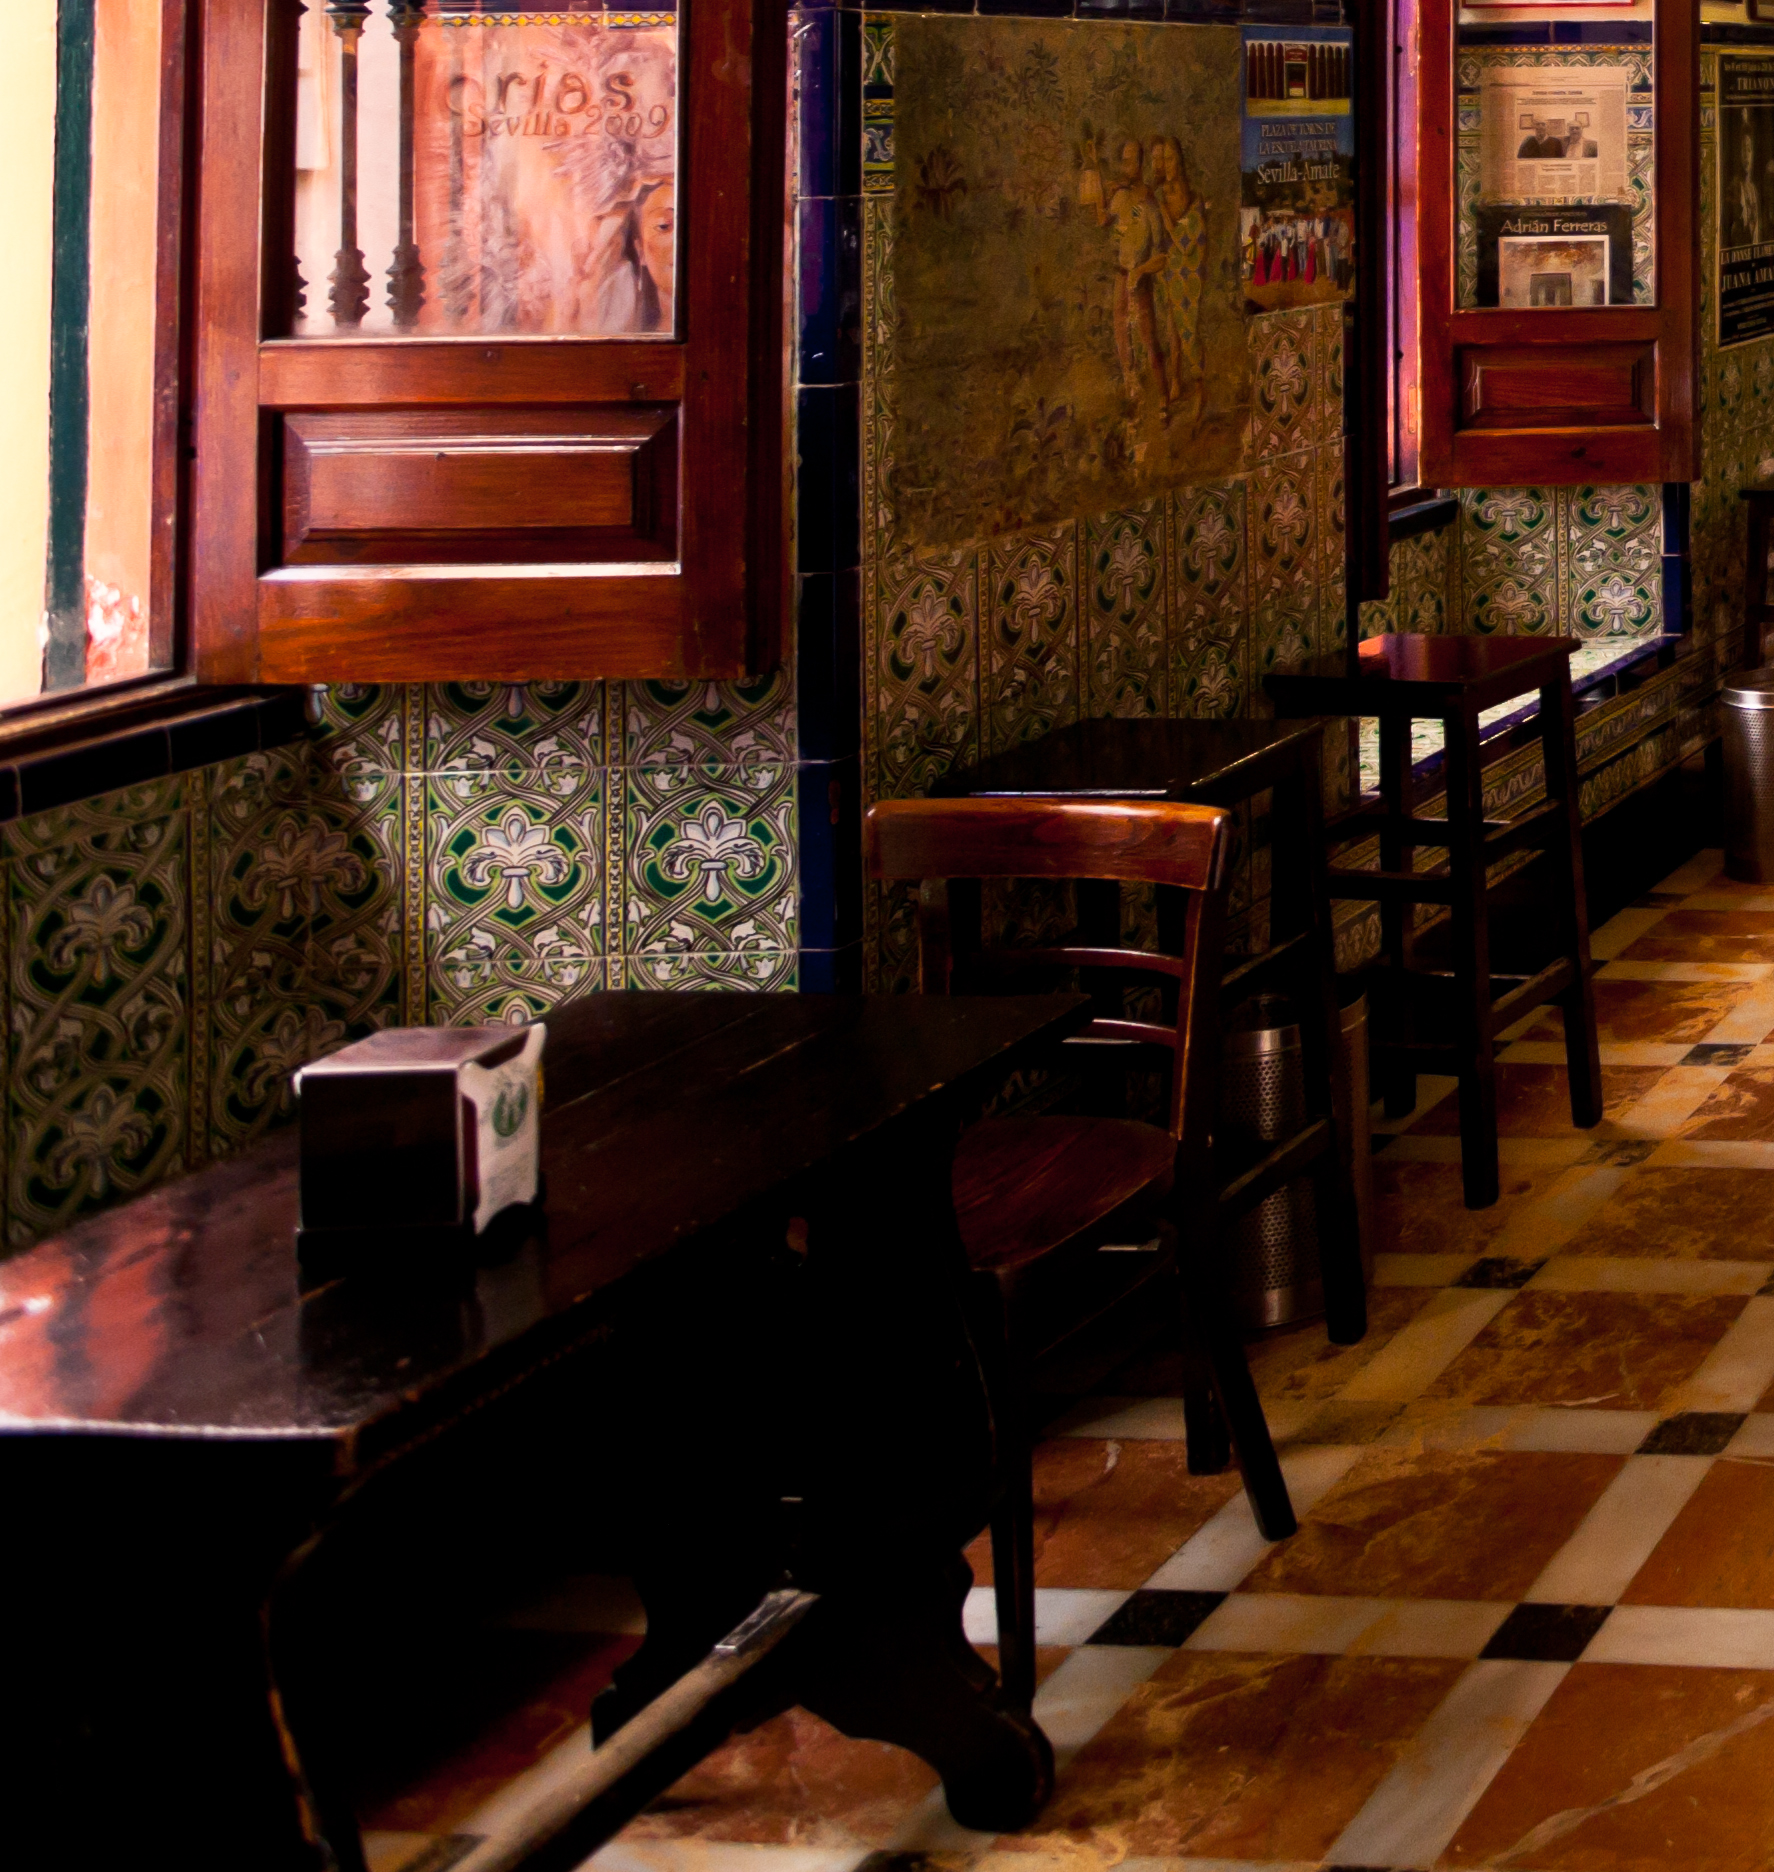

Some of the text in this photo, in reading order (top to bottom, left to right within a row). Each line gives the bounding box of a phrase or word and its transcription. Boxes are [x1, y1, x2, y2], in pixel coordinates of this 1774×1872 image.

[463, 100, 670, 139] Sevilla 2009
[1500, 218, 1608, 234] Adrián Ferreras
